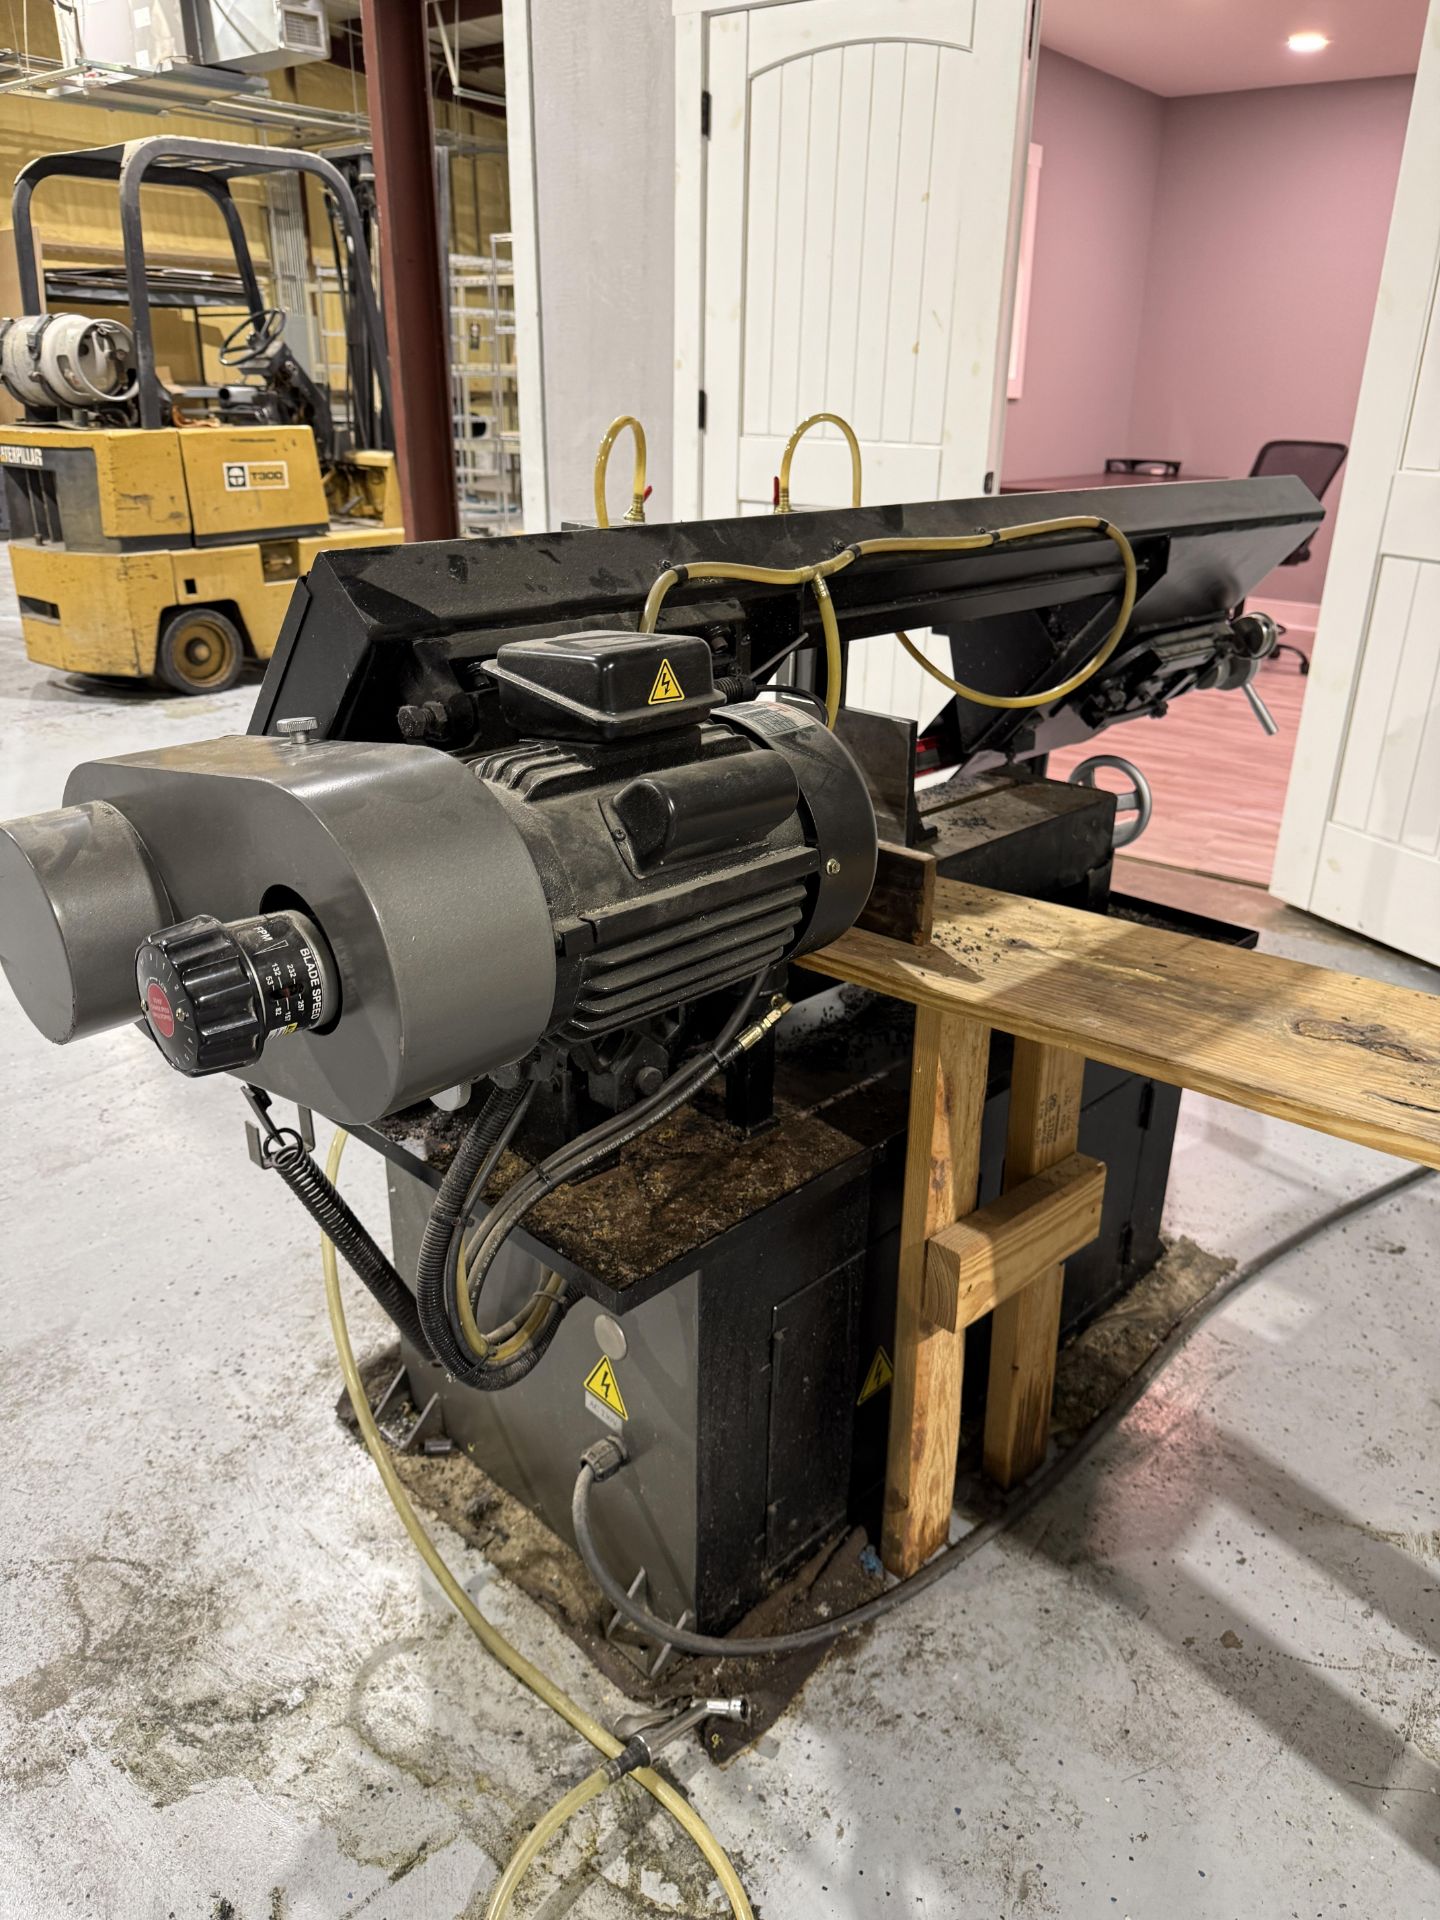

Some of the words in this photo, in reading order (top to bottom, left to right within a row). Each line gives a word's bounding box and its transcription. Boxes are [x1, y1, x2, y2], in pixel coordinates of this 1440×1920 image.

[250, 471, 284, 480] T300
[253, 926, 274, 942] FPM
[271, 962, 281, 977] 132
[286, 963, 297, 978] 232
[299, 947, 320, 987] BLADE
[311, 988, 323, 1020] SPEED
